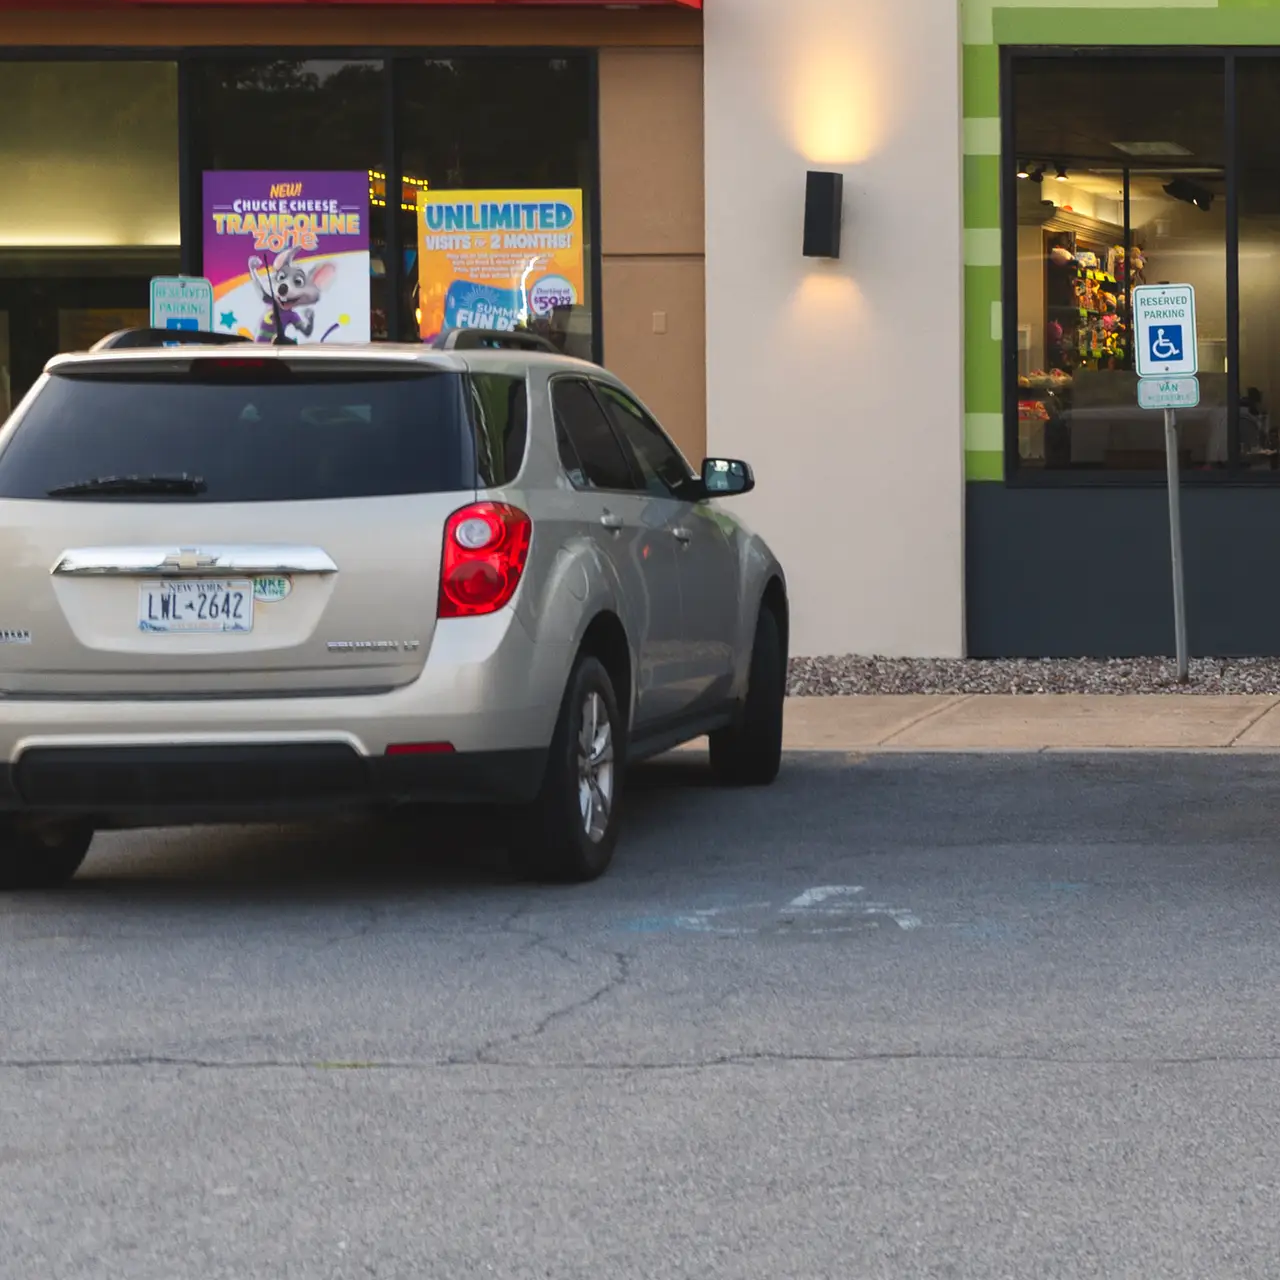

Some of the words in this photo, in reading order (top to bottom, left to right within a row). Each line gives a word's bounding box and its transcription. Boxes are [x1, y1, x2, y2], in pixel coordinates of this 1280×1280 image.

[269, 182, 302, 199] NEW!
[233, 198, 277, 213] CHUCK
[289, 199, 338, 213] CHEESE
[212, 212, 361, 235] TRAMPOLINE
[424, 201, 575, 233] UNLIMITED
[425, 234, 472, 251] VISITS
[490, 233, 501, 249] 2
[504, 233, 573, 250] MONTHS!
[1139, 295, 1188, 307] RESERVED
[456, 308, 494, 330] FUN
[1143, 308, 1186, 319] PARKING
[1158, 382, 1178, 392] VAN
[169, 582, 194, 593] NEW
[196, 582, 224, 593] YORK
[148, 592, 183, 621] LWL
[197, 592, 244, 620] 2642
